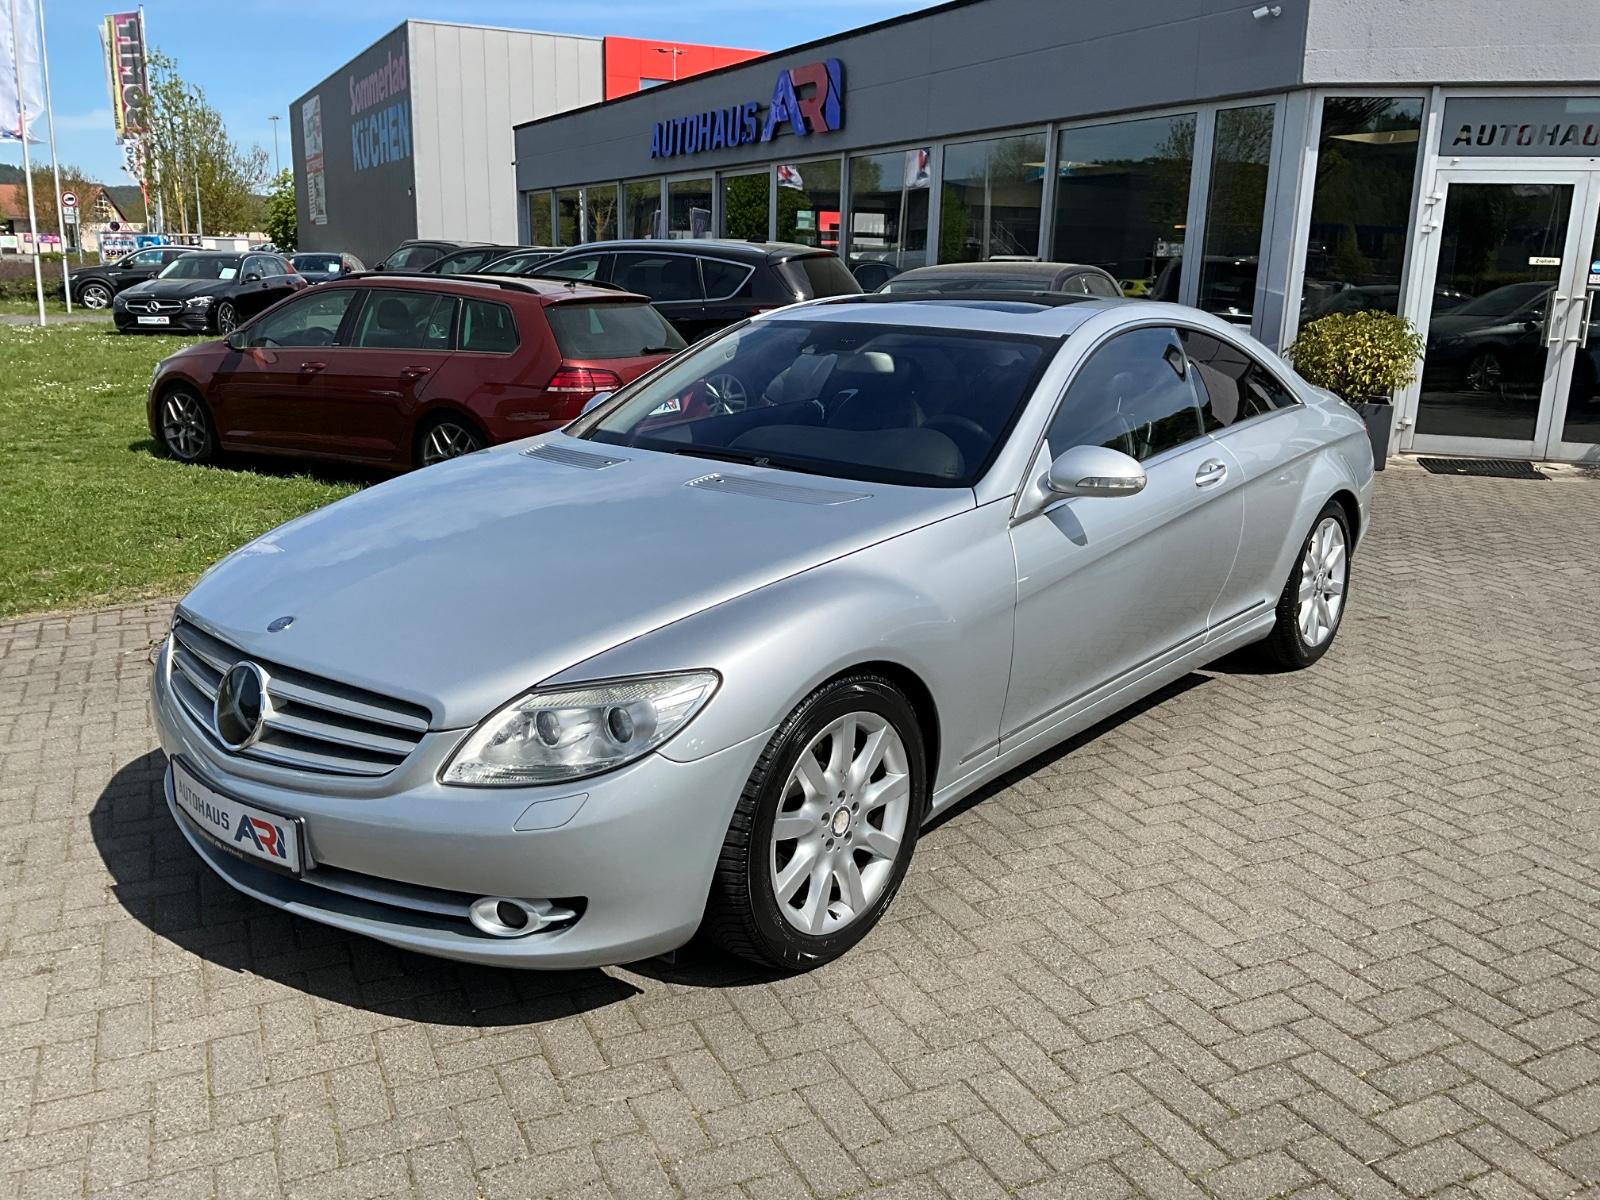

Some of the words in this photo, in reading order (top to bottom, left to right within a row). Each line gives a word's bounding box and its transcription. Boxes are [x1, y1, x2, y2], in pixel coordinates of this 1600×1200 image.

[349, 41, 407, 115] Sommerlad
[650, 100, 759, 159] AUTOHAUS
[761, 57, 844, 142] ARI
[351, 99, 410, 173] KÜCHEN
[178, 780, 230, 830] AUTOHAUS
[234, 814, 287, 859] ARI
